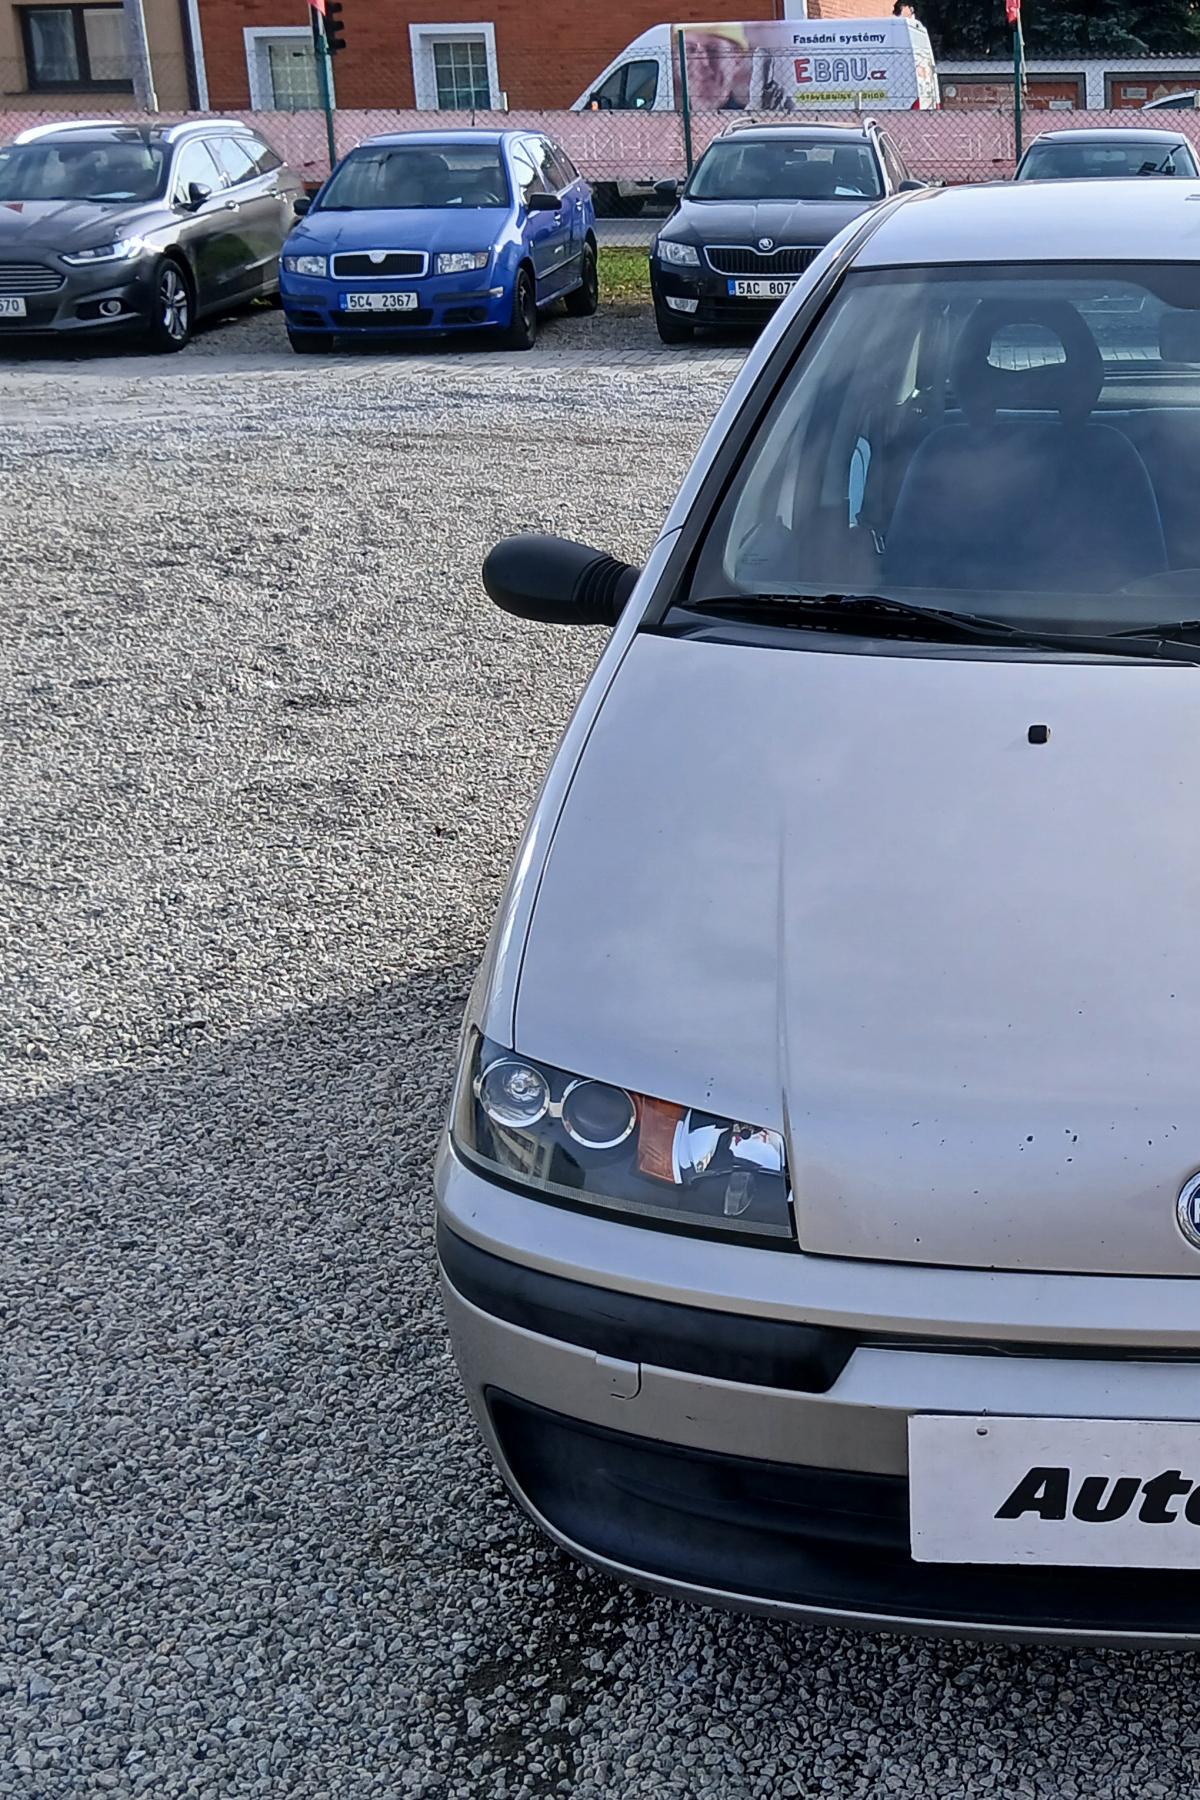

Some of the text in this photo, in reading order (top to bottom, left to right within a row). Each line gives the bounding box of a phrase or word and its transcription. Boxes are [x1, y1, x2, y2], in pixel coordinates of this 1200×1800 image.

[793, 32, 887, 45] Fasádní systémy
[793, 57, 888, 83] EBAU.cz
[737, 282, 797, 294] 5AC 807
[349, 294, 411, 308] 5C4 2367
